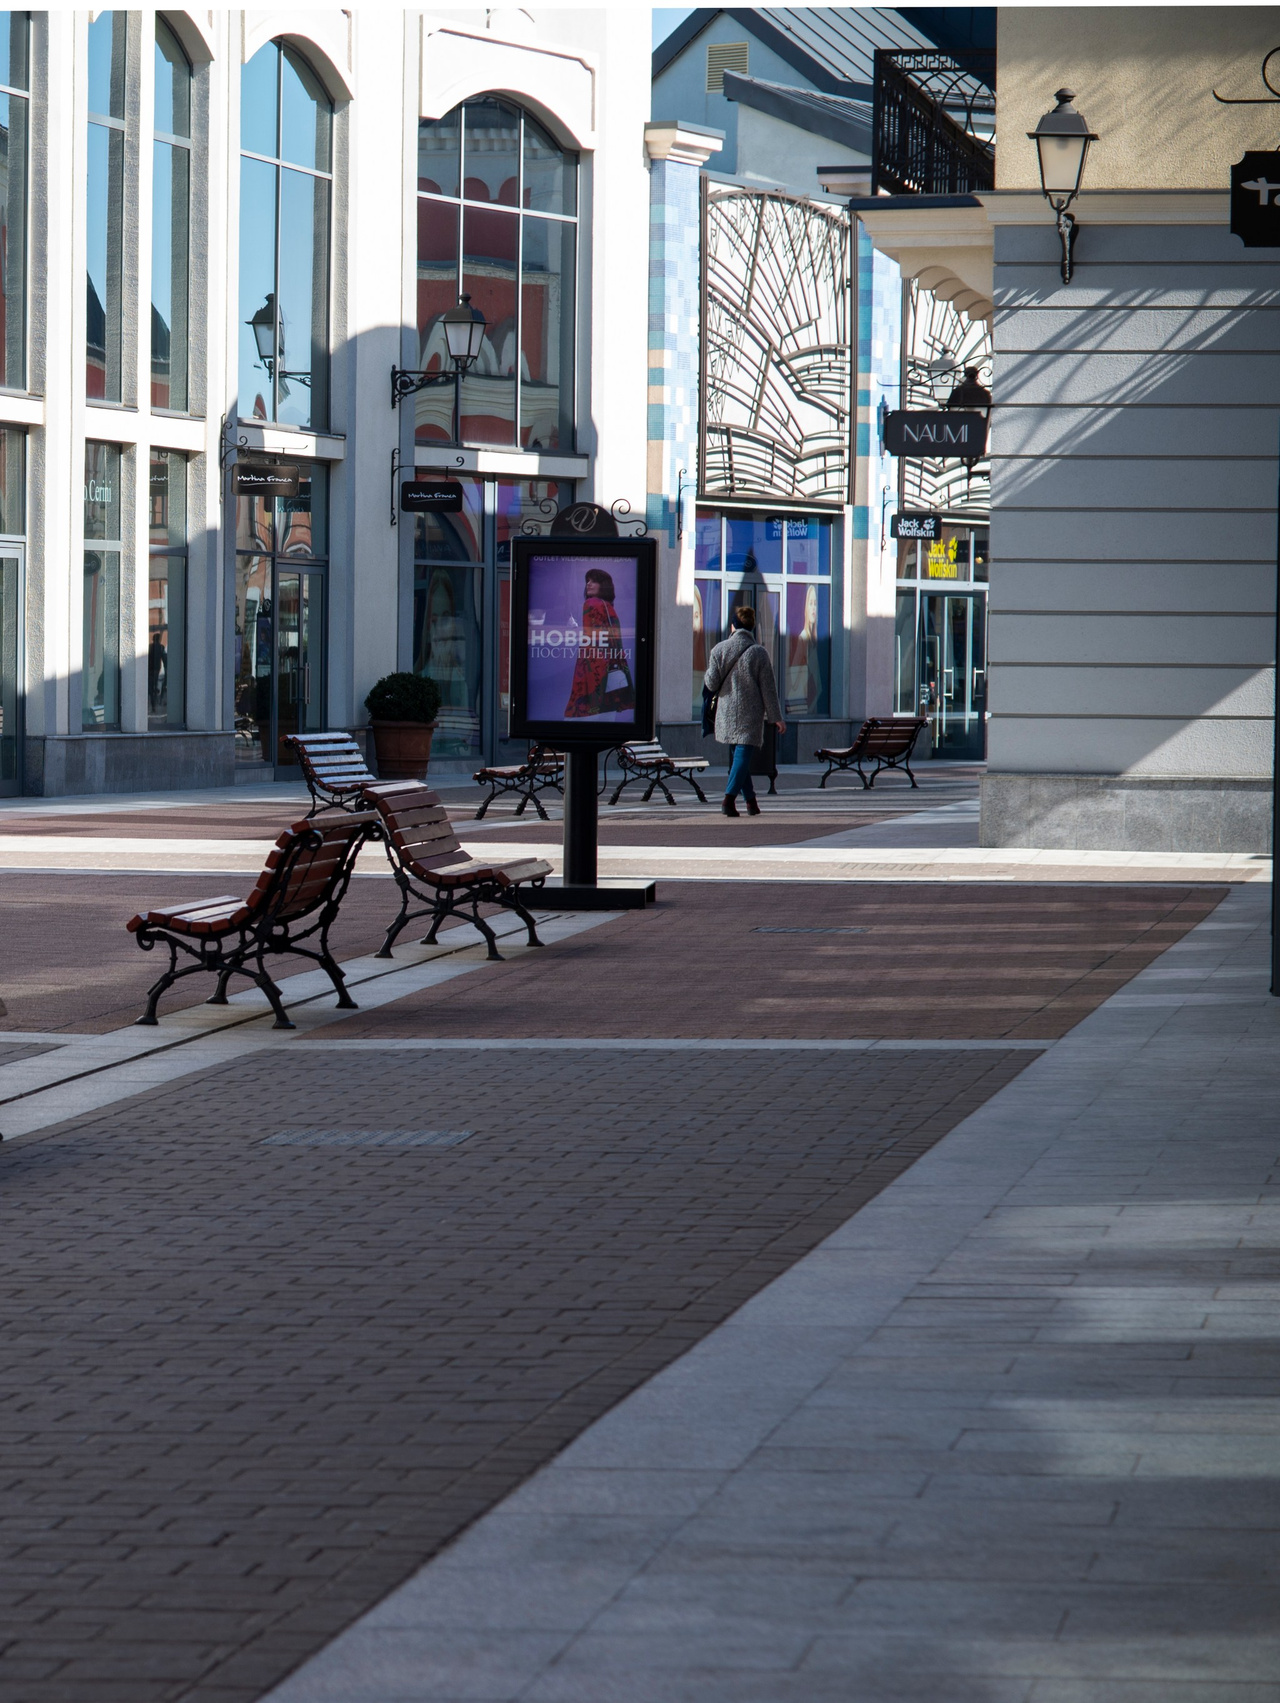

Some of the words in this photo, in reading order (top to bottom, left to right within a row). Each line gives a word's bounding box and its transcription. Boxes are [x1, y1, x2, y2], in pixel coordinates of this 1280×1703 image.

[903, 423, 969, 443] NAUMI
[237, 474, 266, 482] Martina
[89, 479, 112, 502] Cerini
[898, 518, 920, 528] Jack
[898, 527, 935, 538] Wolfskin
[928, 539, 946, 557] Jack
[928, 559, 958, 579] Wolfskin
[531, 630, 609, 647] НОВЫЕ
[531, 647, 632, 659] ПОСТУПЛЕНИЯ
